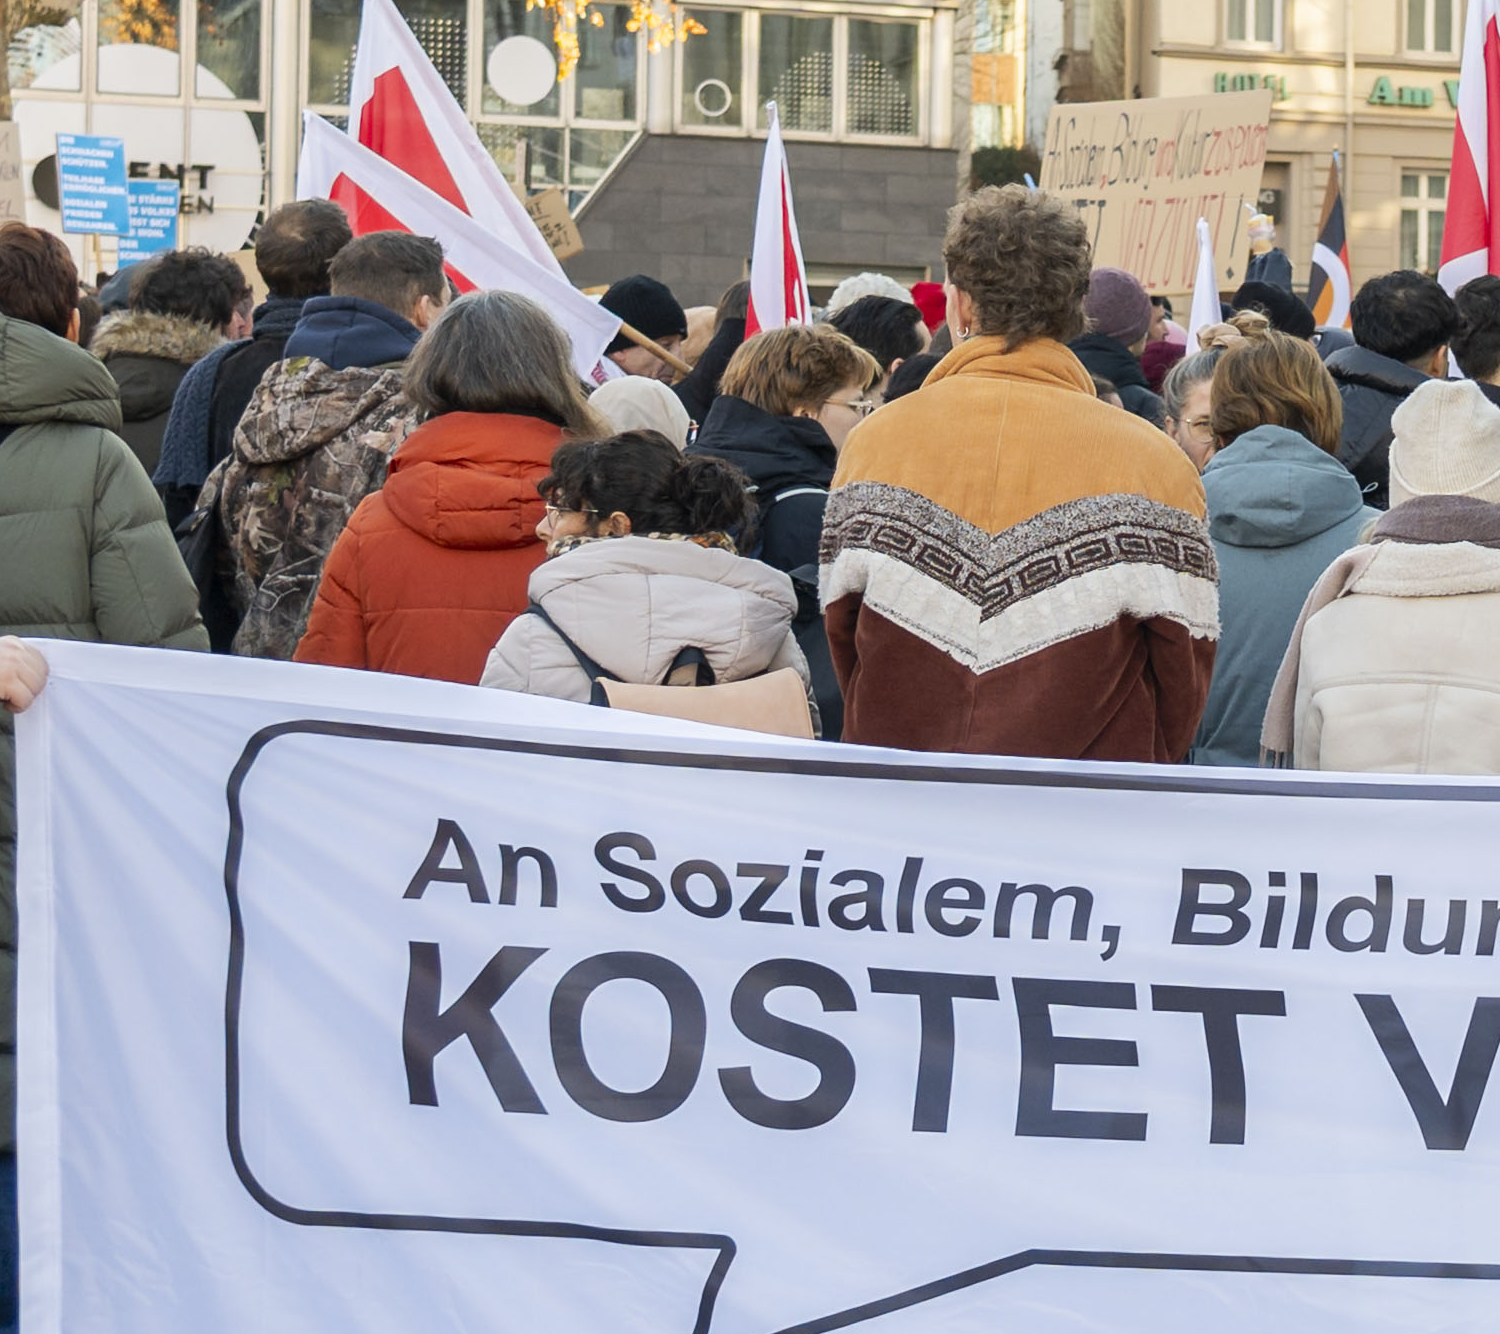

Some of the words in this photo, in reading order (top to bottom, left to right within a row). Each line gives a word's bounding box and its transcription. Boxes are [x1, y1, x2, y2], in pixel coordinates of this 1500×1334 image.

[1214, 72, 1289, 101] HOTEL
[1369, 76, 1433, 108] Am
[402, 818, 558, 908] An
[594, 831, 1121, 962] Sozialem,
[401, 933, 1287, 1146] KOSTET
